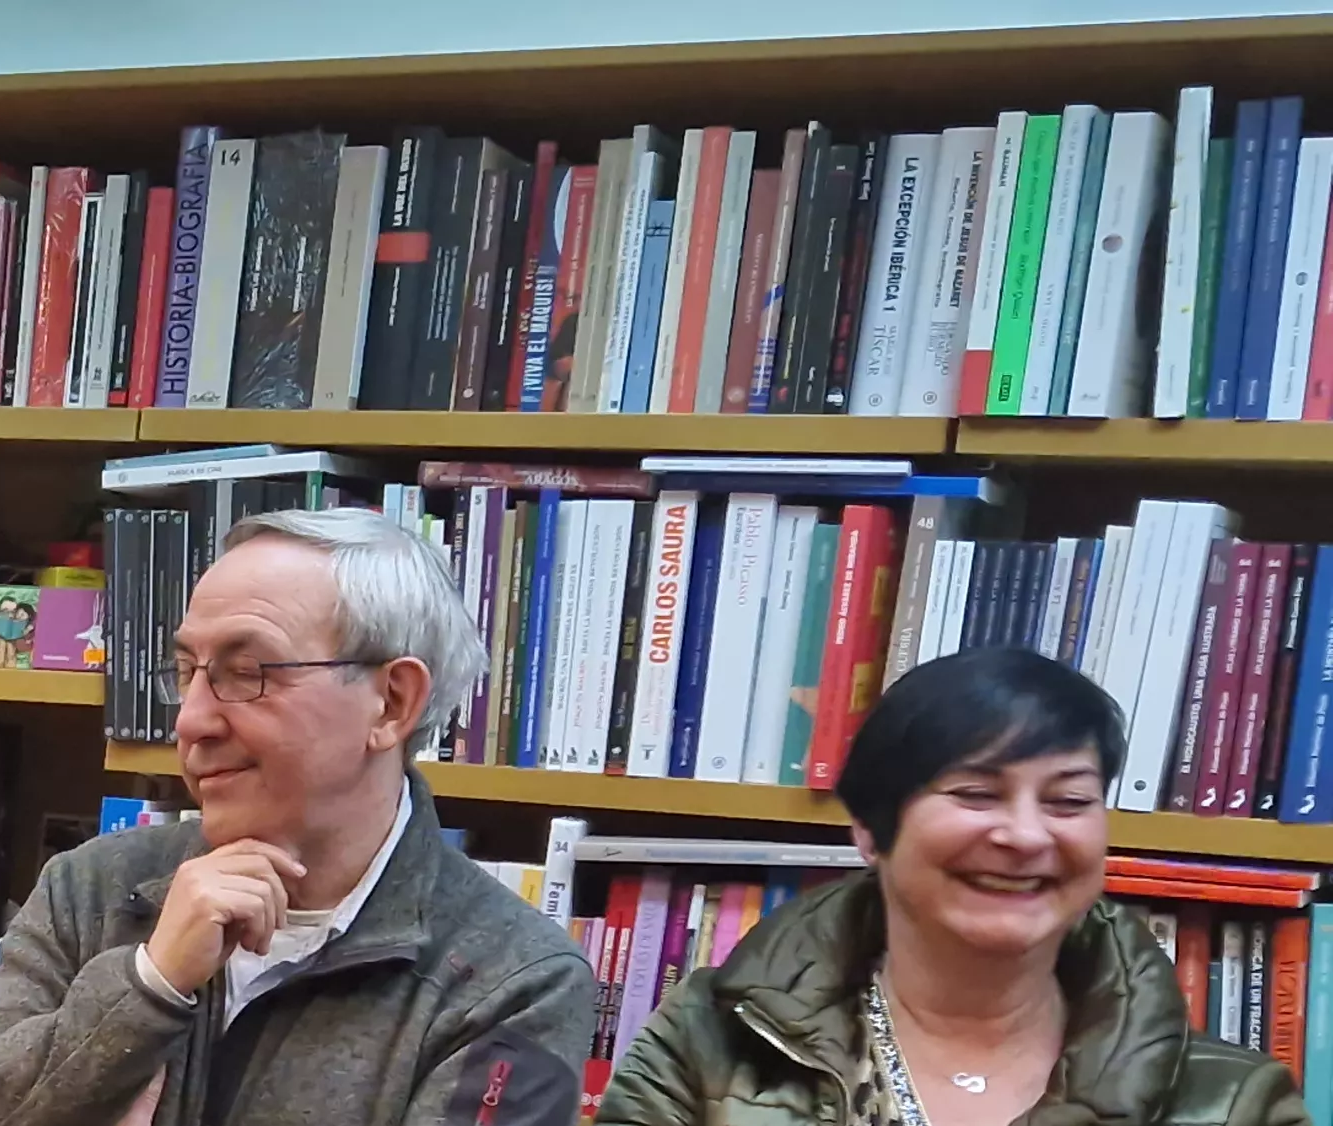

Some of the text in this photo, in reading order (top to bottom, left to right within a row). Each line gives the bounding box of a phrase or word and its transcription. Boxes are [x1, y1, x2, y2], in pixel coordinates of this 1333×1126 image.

[219, 148, 242, 167] 14
[904, 156, 920, 173] LA
[972, 150, 984, 163] LA
[392, 214, 403, 226] LA
[893, 176, 918, 249] EXCEPCIÓN
[962, 212, 974, 224] DE
[162, 142, 207, 395] HISTORIA-BIOGRAFIA
[884, 251, 906, 302] IBÉRICA
[956, 255, 968, 267] DE
[521, 278, 554, 391] ¡VIVA EL MAQUIS!
[866, 324, 887, 377] TÍSCAR
[659, 506, 687, 576] SAURA
[736, 506, 765, 606] Pablo Picasso
[1234, 597, 1245, 607] LA
[1264, 598, 1274, 608] LA
[649, 582, 679, 664] CARLOS
[1180, 764, 1193, 774] EL
[1200, 605, 1218, 653] ILUSTRADA
[554, 841, 568, 853] 34
[1250, 973, 1263, 1004] DE UN
